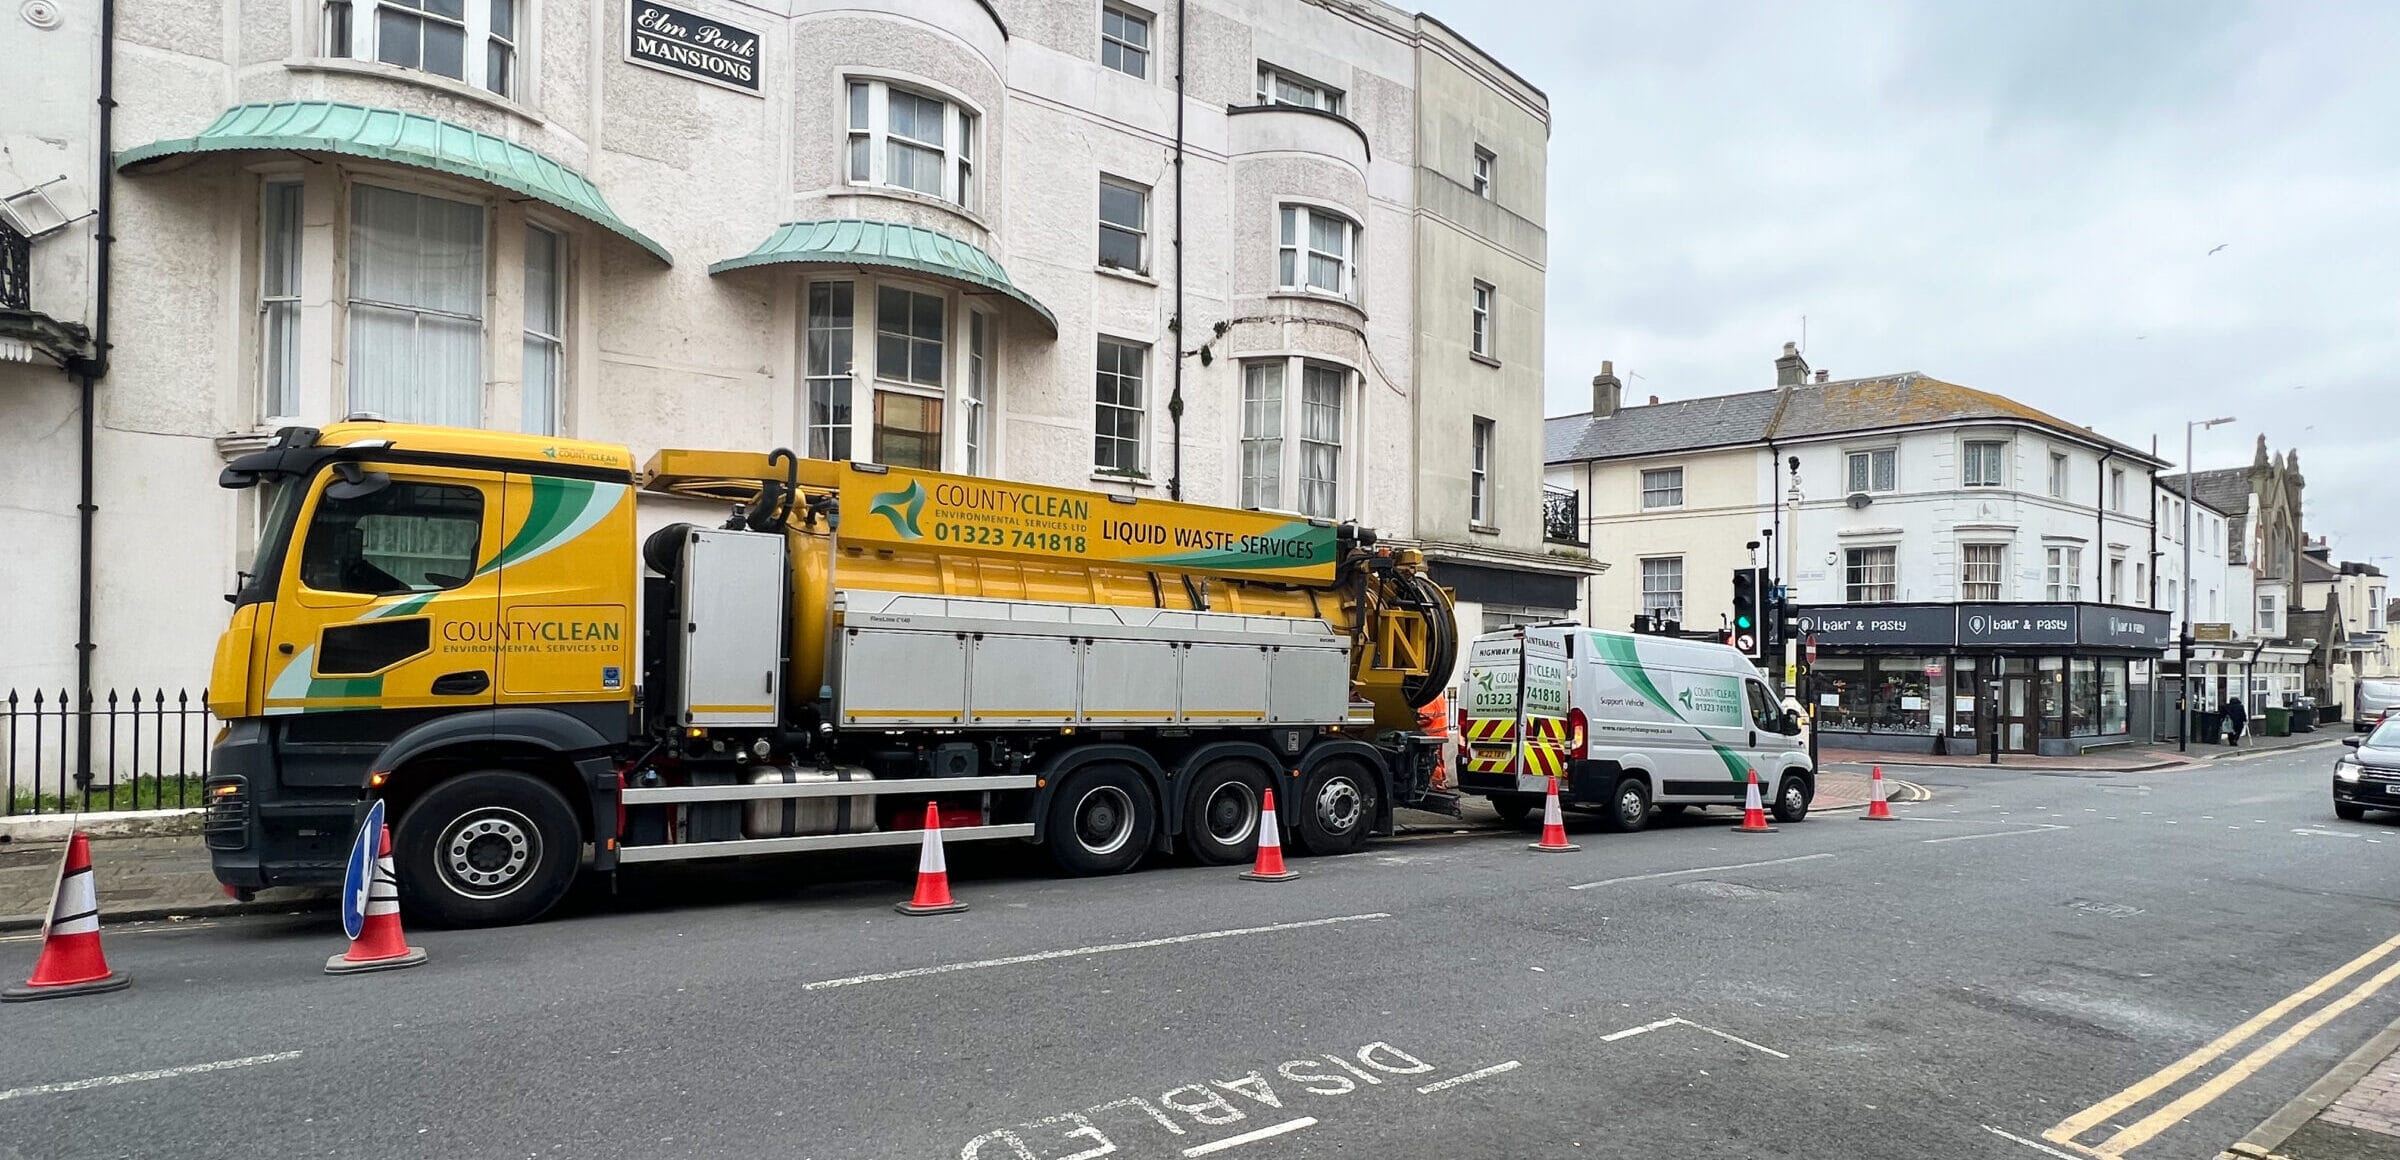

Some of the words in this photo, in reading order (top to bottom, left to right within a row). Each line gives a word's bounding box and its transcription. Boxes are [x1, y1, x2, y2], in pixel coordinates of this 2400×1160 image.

[637, 8, 688, 38] Elm
[695, 25, 755, 57] Park
[636, 35, 752, 82] MANSIONS
[936, 483, 1088, 521] COUNTYCLEAN
[935, 509, 1020, 526] ENVIRONMENTAL
[1025, 518, 1068, 531] SERVICES
[1071, 523, 1087, 533] LTD
[935, 523, 1004, 546] 01323
[1011, 530, 1087, 554] 741818
[1102, 519, 1167, 545] LIQUID
[1174, 527, 1234, 552] WASTE
[1240, 534, 1313, 559] SERVICES
[443, 621, 619, 642] COUNTYCLEAN
[1855, 620, 1865, 631] &
[2023, 619, 2032, 630] &
[443, 644, 541, 653] ENVIRONMENTAL
[546, 644, 597, 653] SERVICES
[600, 644, 619, 652] LTD
[1480, 648, 1510, 656] HIGHWAY
[1476, 693, 1512, 705] 01323
[1527, 687, 1561, 703] 741818
[1694, 687, 1737, 699] COUNTYCLEAN
[1600, 696, 1624, 707] Support
[1625, 697, 1644, 708] Vehicle
[1695, 702, 1715, 712] 01323
[1716, 704, 1738, 713] 741818
